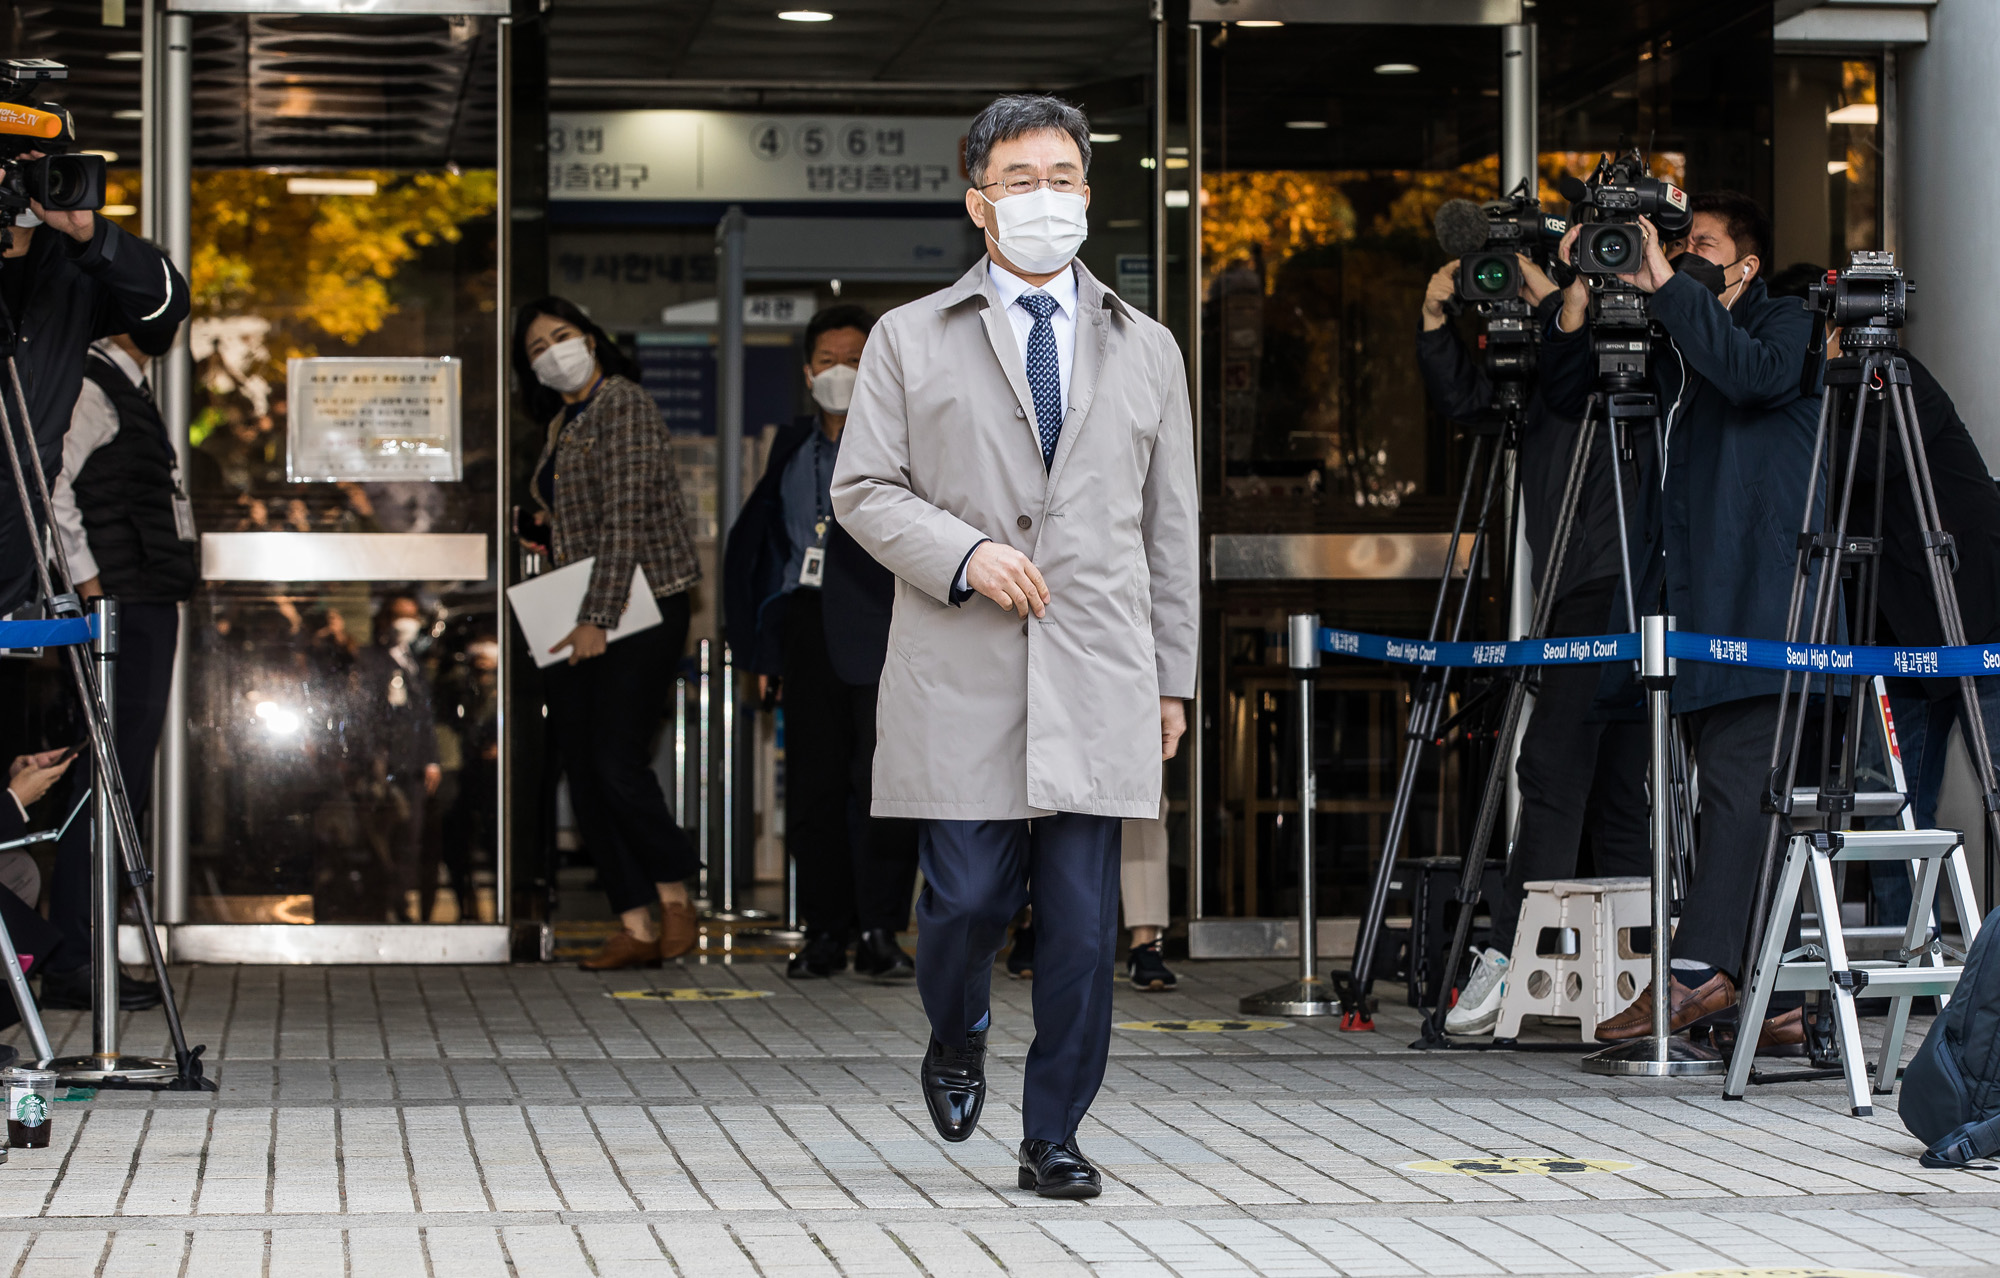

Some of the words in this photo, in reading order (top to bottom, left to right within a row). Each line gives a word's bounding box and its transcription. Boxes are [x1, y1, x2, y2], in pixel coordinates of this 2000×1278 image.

[0, 108, 39, 126] 합뉴스TV
[806, 164, 948, 192] 법정출입구
[1544, 217, 1567, 233] KBS
[1330, 632, 1359, 653] 서울고등법원
[1386, 640, 1403, 658] Seoul
[1404, 643, 1419, 662] High
[1419, 645, 1437, 662] Court
[1543, 642, 1567, 660] Seoul
[1570, 641, 1589, 661] High
[1593, 640, 1617, 657] Court
[1709, 638, 1748, 662] 서울고등법원
[1472, 645, 1507, 664] 서울고등법원
[1786, 646, 1808, 666] Seoul
[1810, 649, 1829, 670] High
[1831, 649, 1853, 668] Court
[1893, 651, 1938, 673] 서울고등법원
